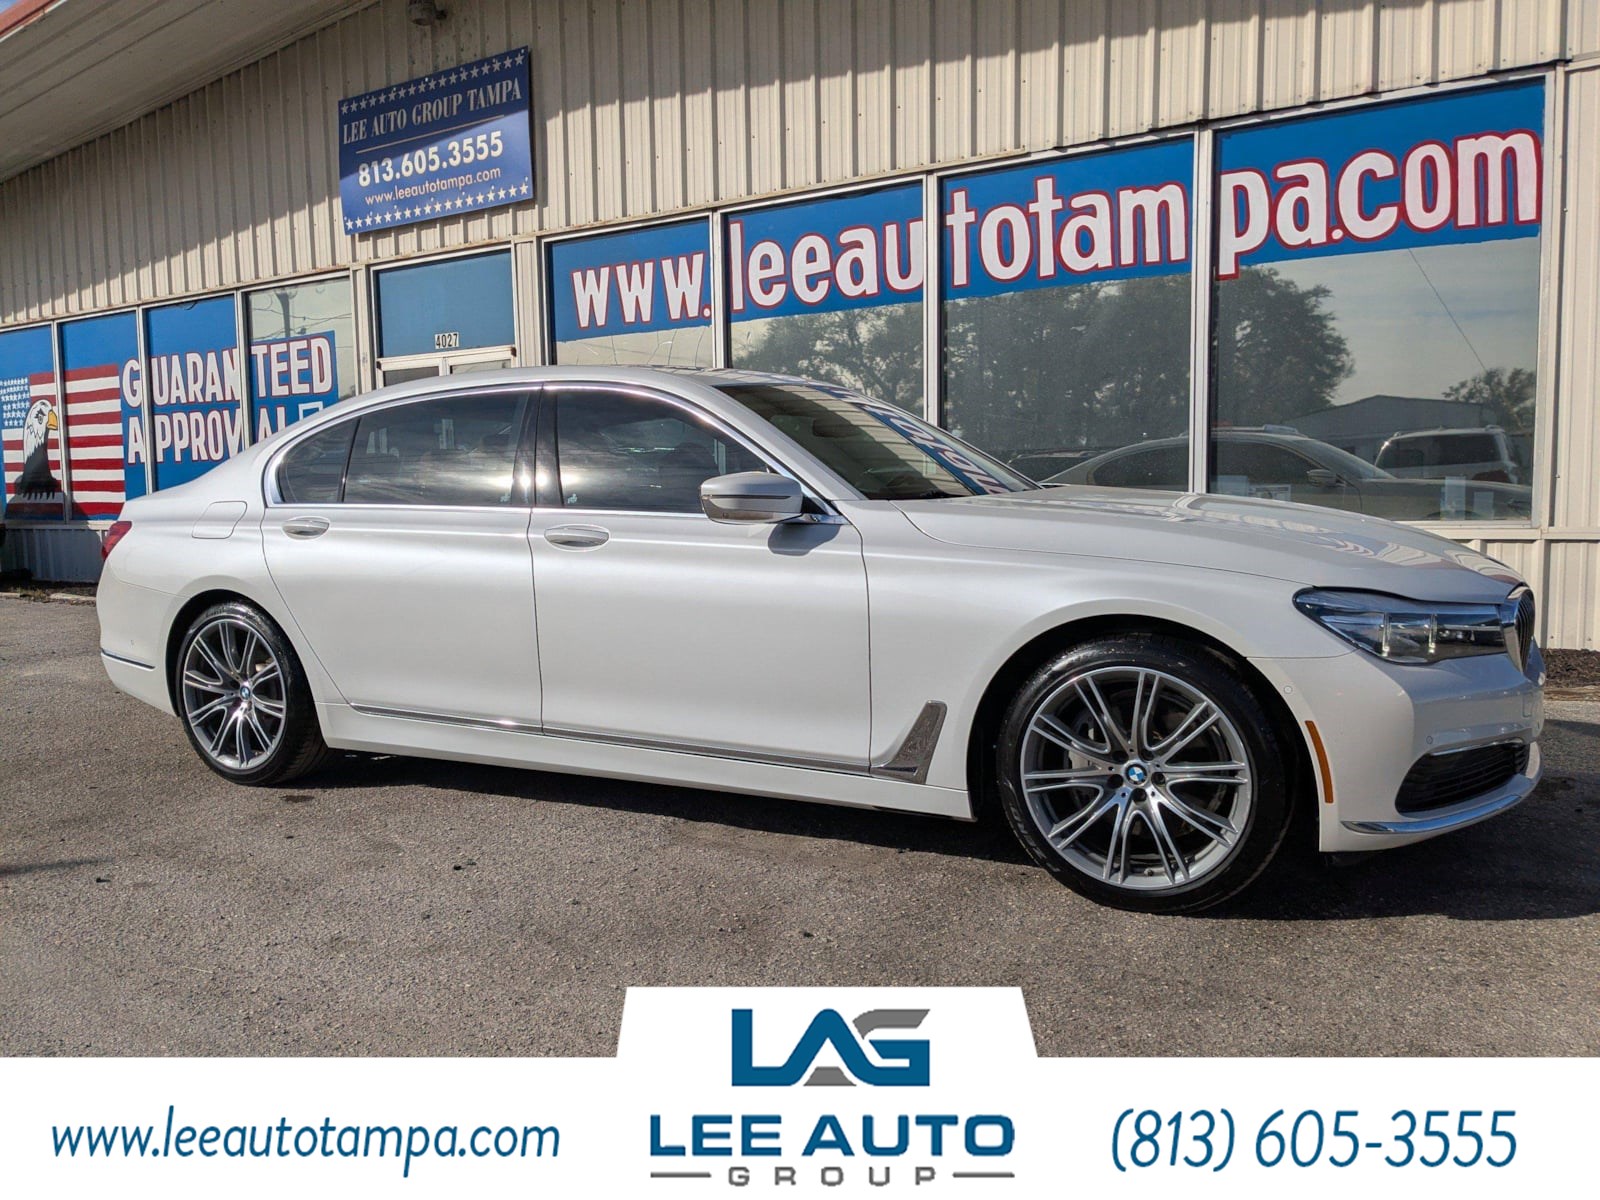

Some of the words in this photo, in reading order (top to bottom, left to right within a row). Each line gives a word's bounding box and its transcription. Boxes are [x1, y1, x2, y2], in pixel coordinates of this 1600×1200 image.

[343, 118, 367, 145] LEE
[371, 108, 407, 136] AUTO
[412, 93, 463, 126] GROUP
[467, 77, 522, 112] TAMPA
[358, 130, 504, 187] 813.605.3555
[364, 167, 501, 205] www.leeautotampa.com
[436, 332, 458, 349] 4027
